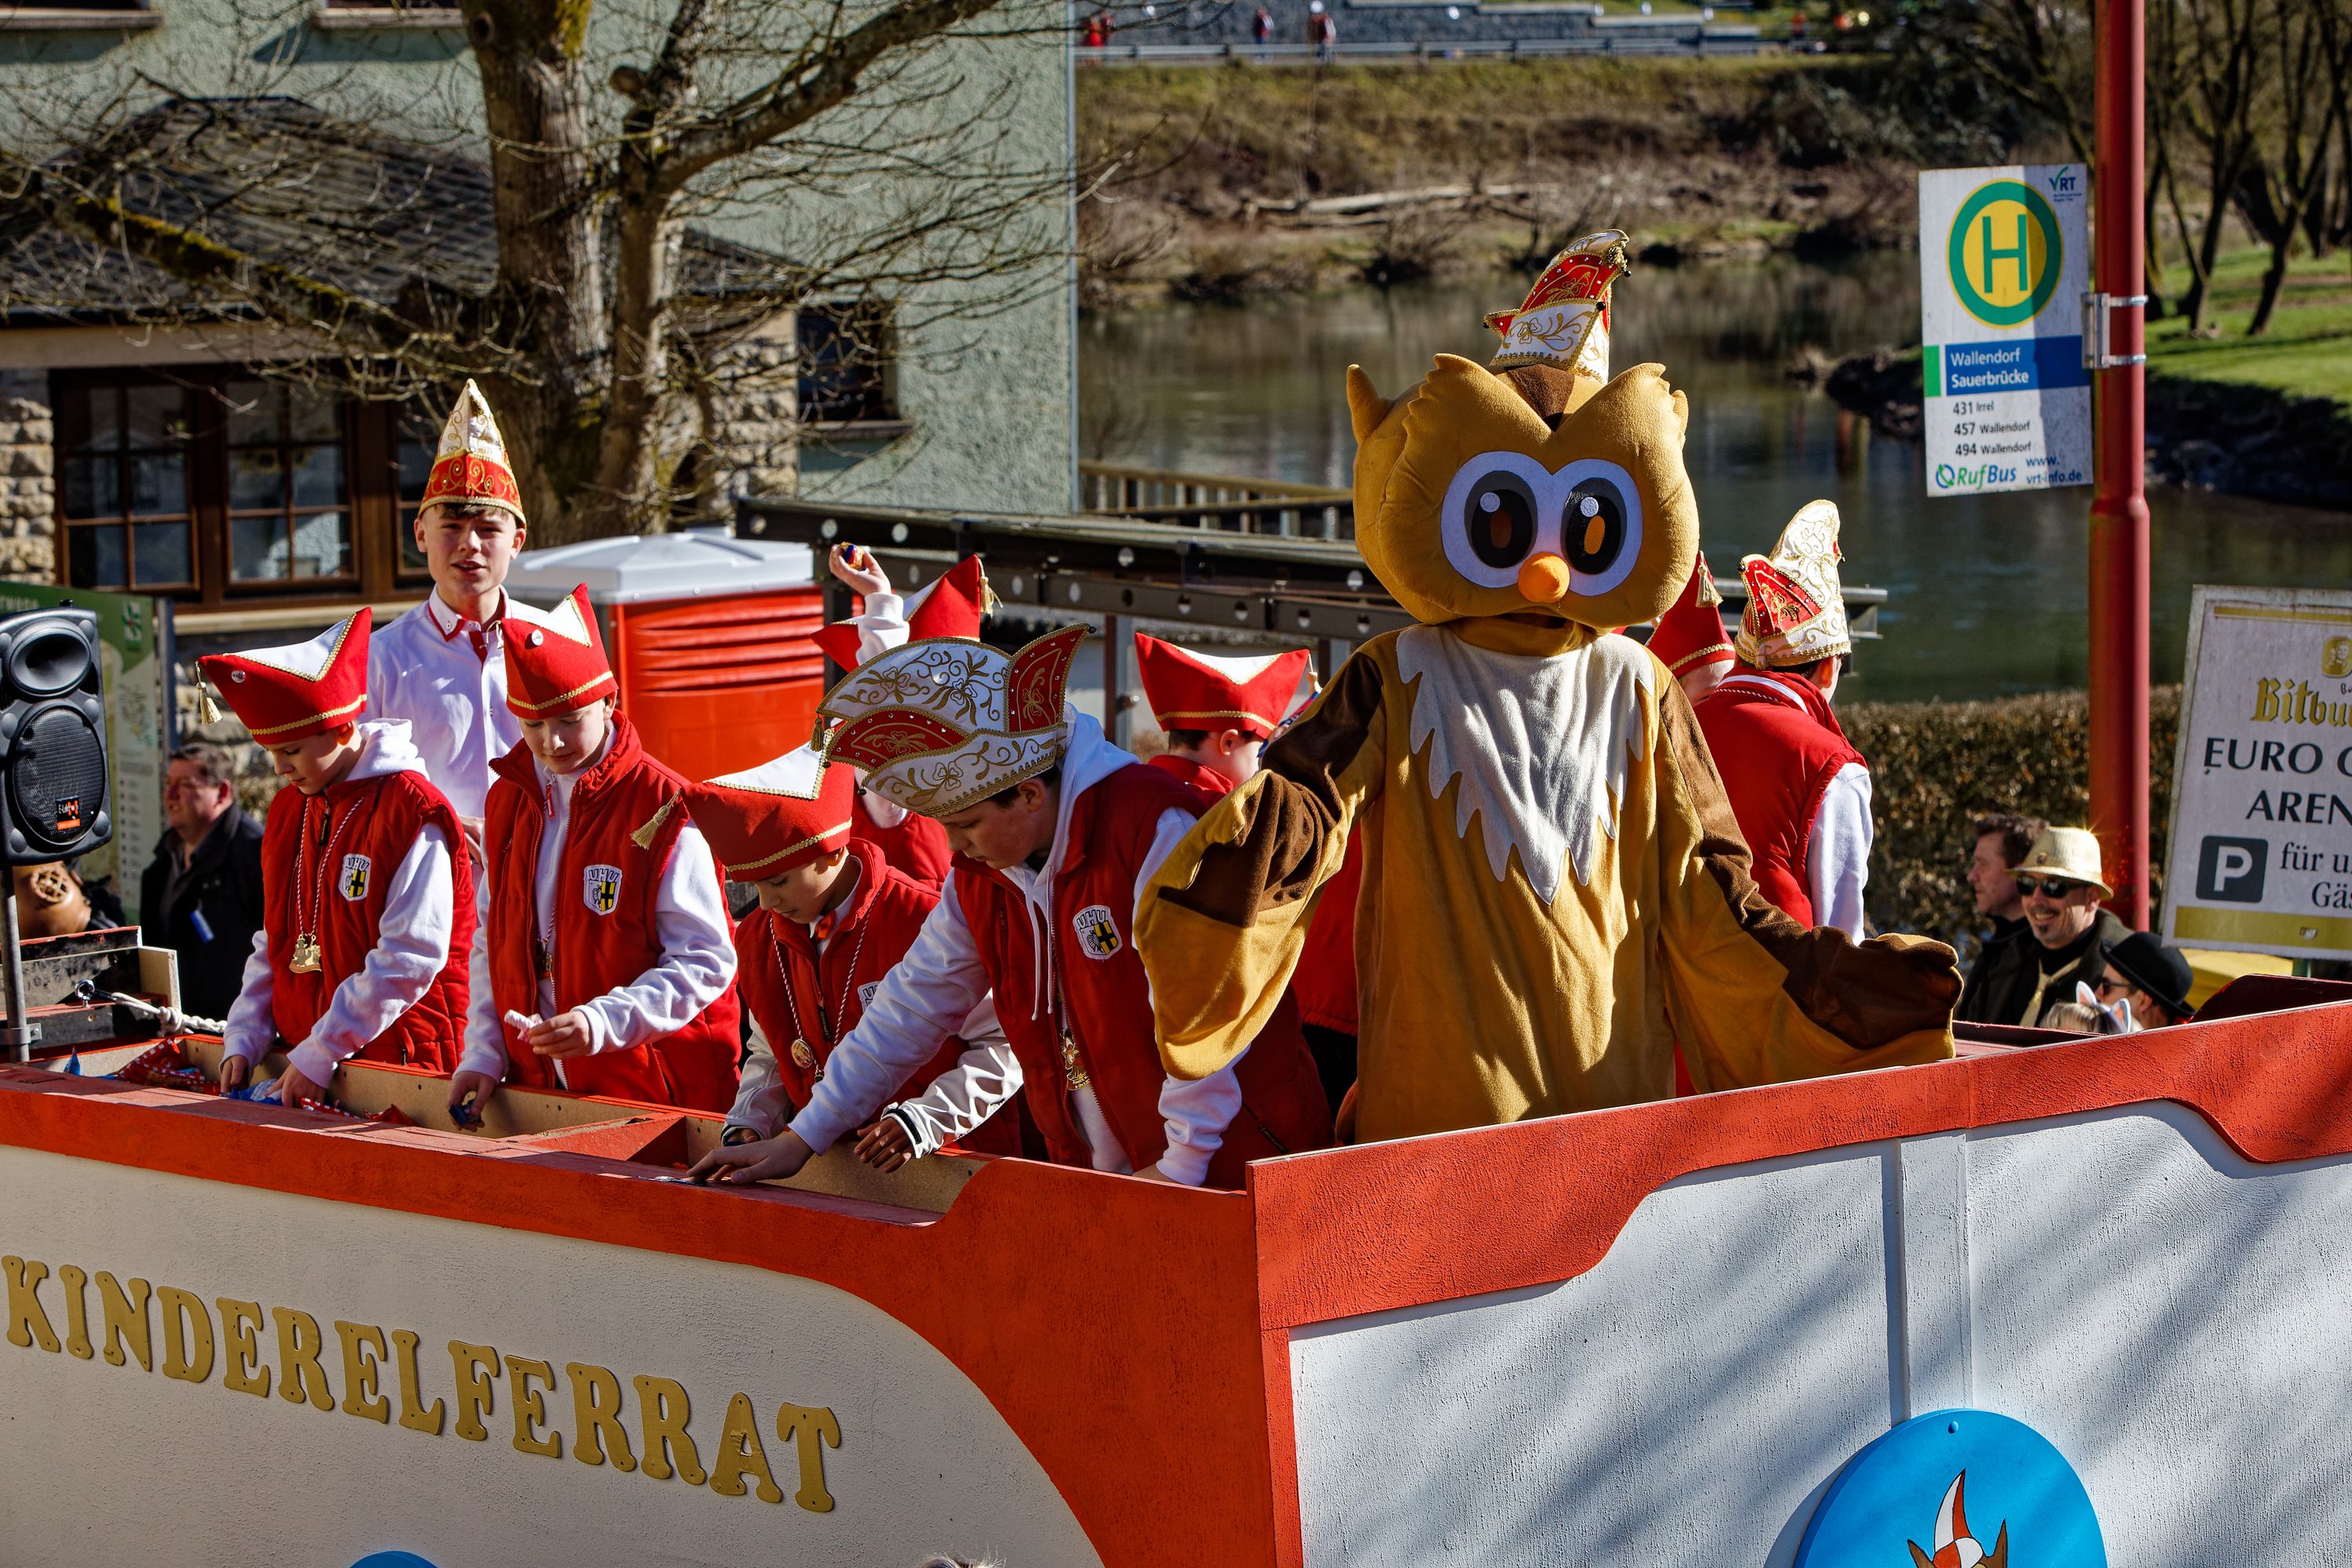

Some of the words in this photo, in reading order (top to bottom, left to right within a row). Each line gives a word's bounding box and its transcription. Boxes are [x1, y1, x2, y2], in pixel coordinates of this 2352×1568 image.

[2049, 165, 2076, 191] VRT
[1982, 213, 2028, 294] H
[1951, 347, 2021, 367] Wallendorf
[1951, 368, 2029, 389] Sauerbrücke
[1953, 401, 1973, 415] 431
[1976, 401, 1994, 412] Irrel
[1954, 422, 1976, 436] 457
[1980, 419, 2031, 434] Wallendorf
[1955, 443, 1977, 456] 494
[1980, 441, 2032, 454] Wallendorf
[2026, 456, 2060, 467] www.
[1958, 464, 2017, 491] RufBus
[2026, 469, 2082, 484] vrt-info.de
[2204, 737, 2323, 774] EURO
[346, 857, 370, 872] UHU
[2280, 841, 2324, 872] für
[589, 868, 619, 883] UHU
[2213, 845, 2253, 892] P
[1076, 909, 1106, 929] UHU
[2, 1255, 841, 1512] KINDERELFERRAT
